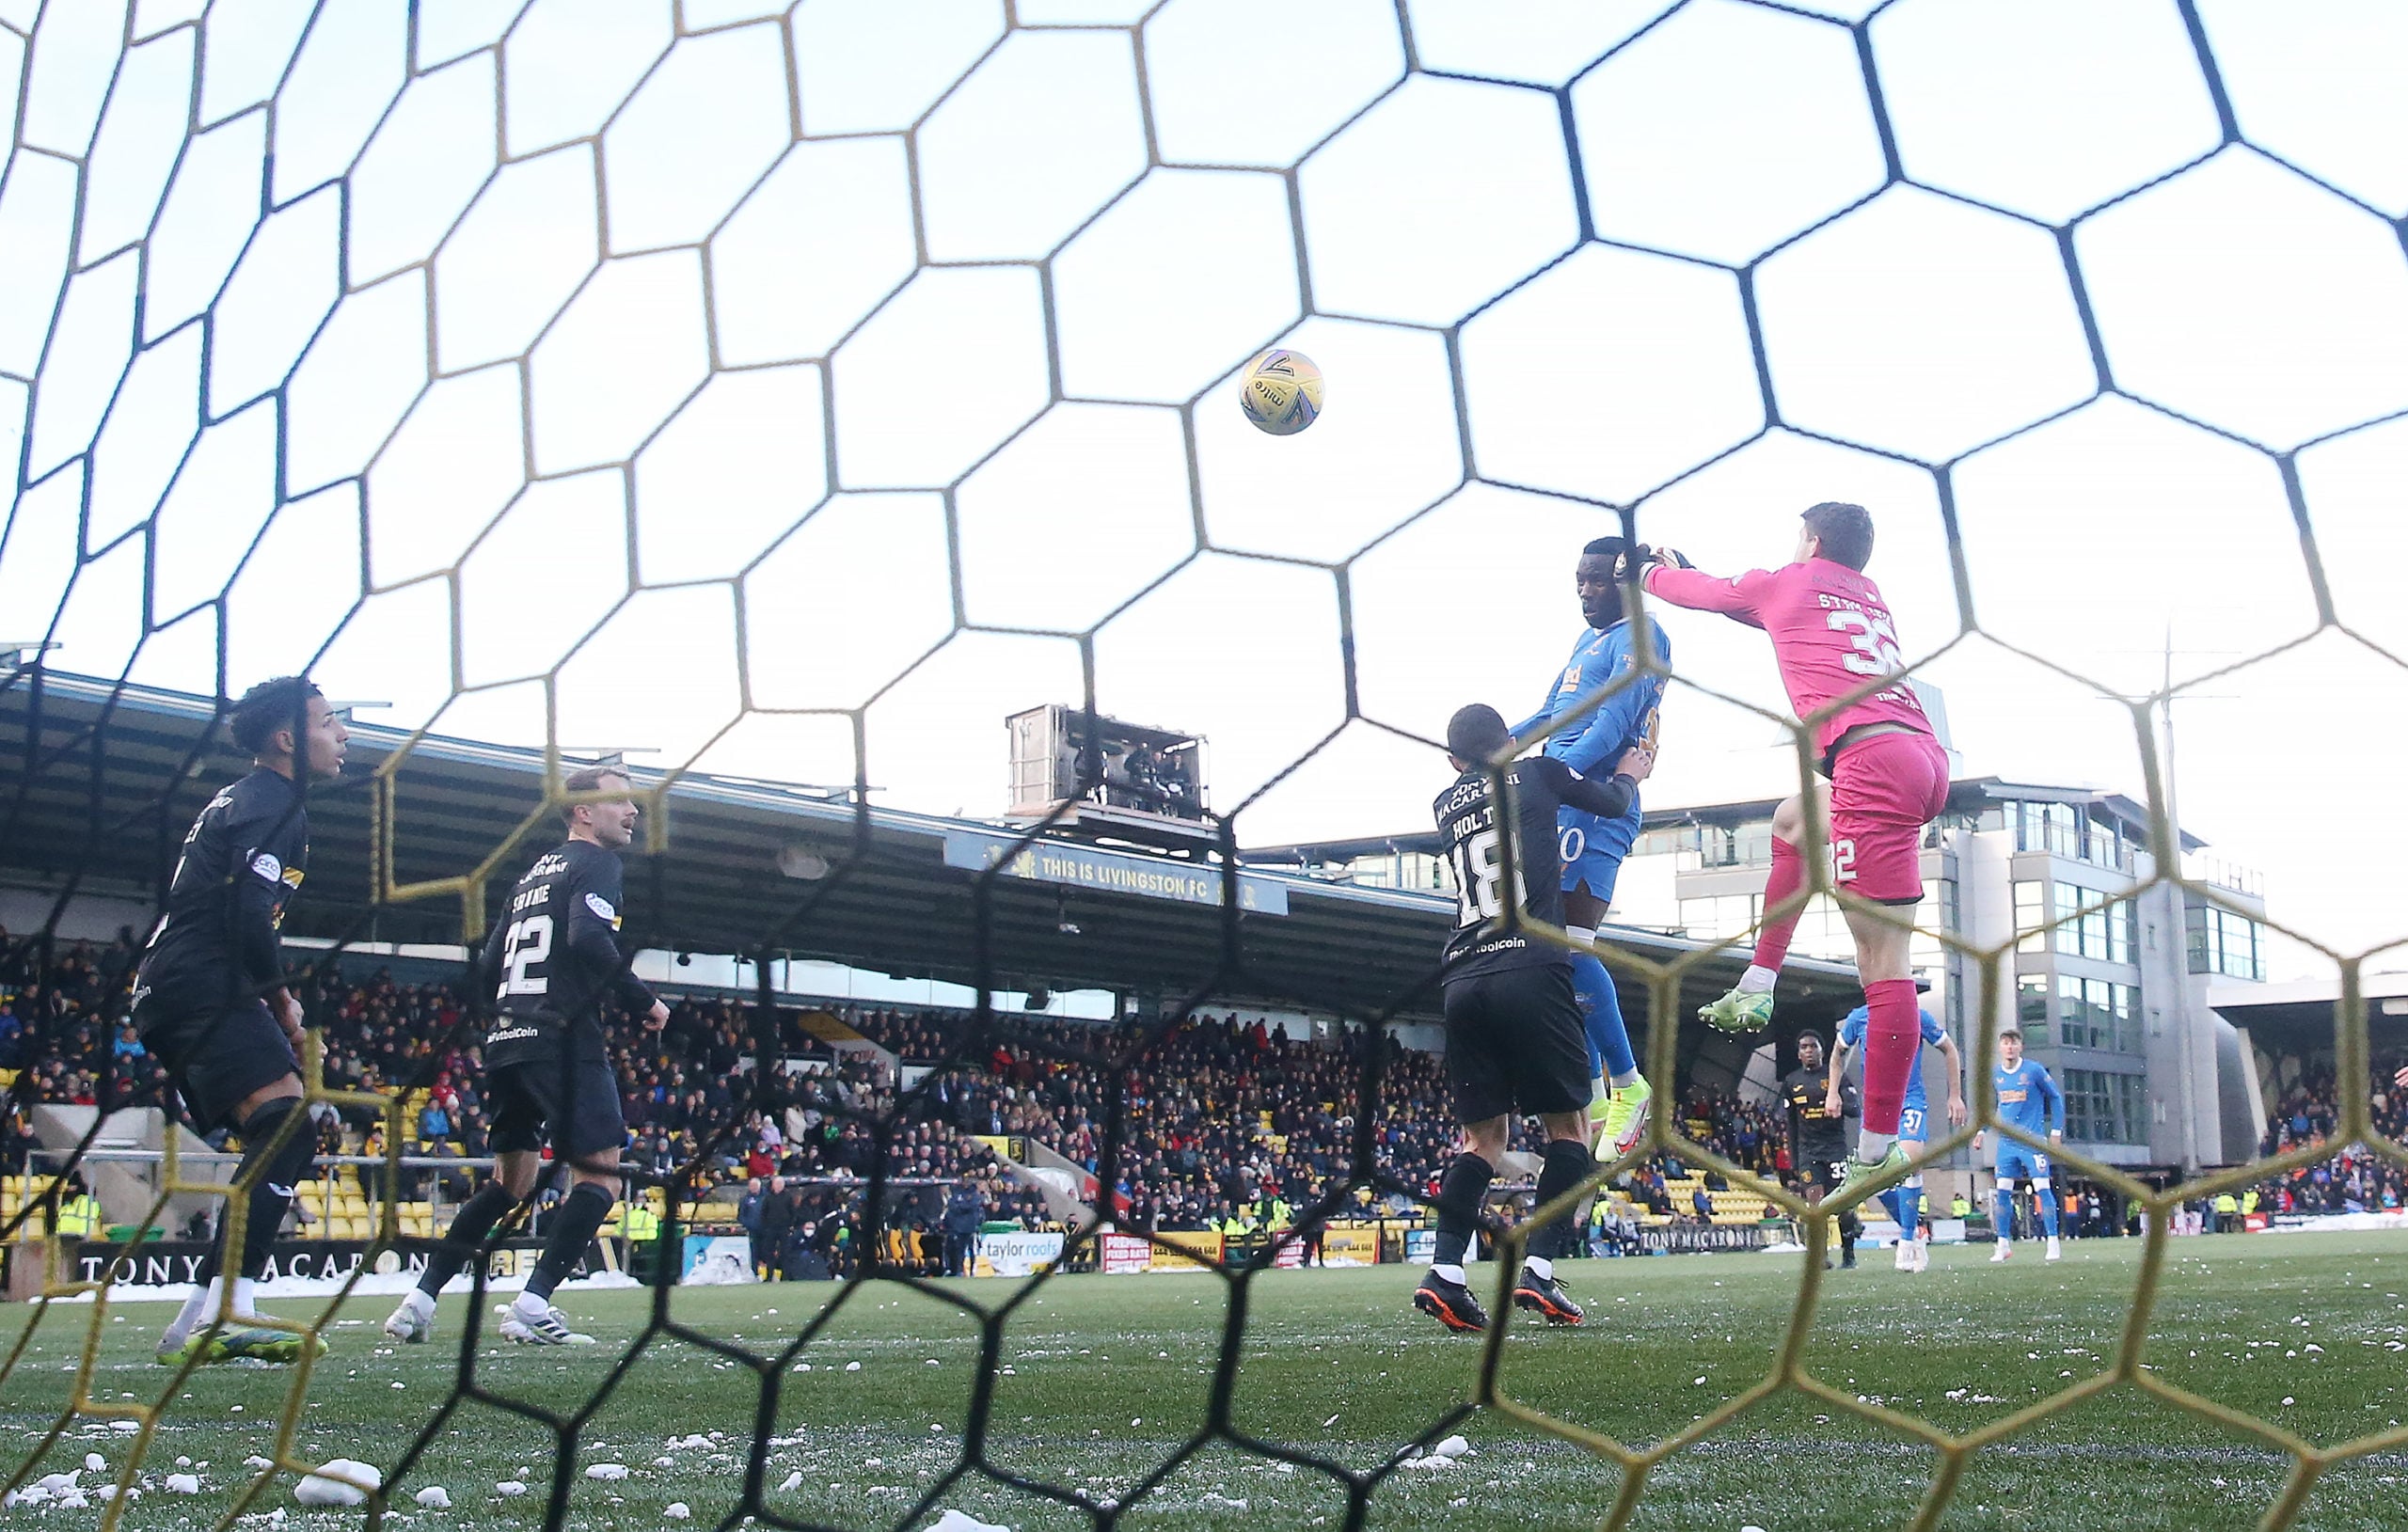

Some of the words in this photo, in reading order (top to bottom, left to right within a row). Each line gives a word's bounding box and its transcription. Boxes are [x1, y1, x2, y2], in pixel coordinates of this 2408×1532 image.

[1255, 380, 1284, 406] mitre
[1452, 806, 1495, 843] HOLT
[1042, 857, 1075, 878] THIS
[1080, 862, 1093, 880] IS
[1099, 865, 1184, 894] LIVINGSTON
[1189, 879, 1207, 897] FC
[1453, 829, 1529, 929] 18
[497, 914, 554, 1001] 22
[1903, 1109, 1923, 1129] 37
[988, 1240, 1024, 1258] taylor
[1026, 1240, 1058, 1256] roofs
[1642, 1232, 1676, 1249] TONY
[1682, 1230, 1751, 1248] MACARONI
[79, 1255, 205, 1286] TONY
